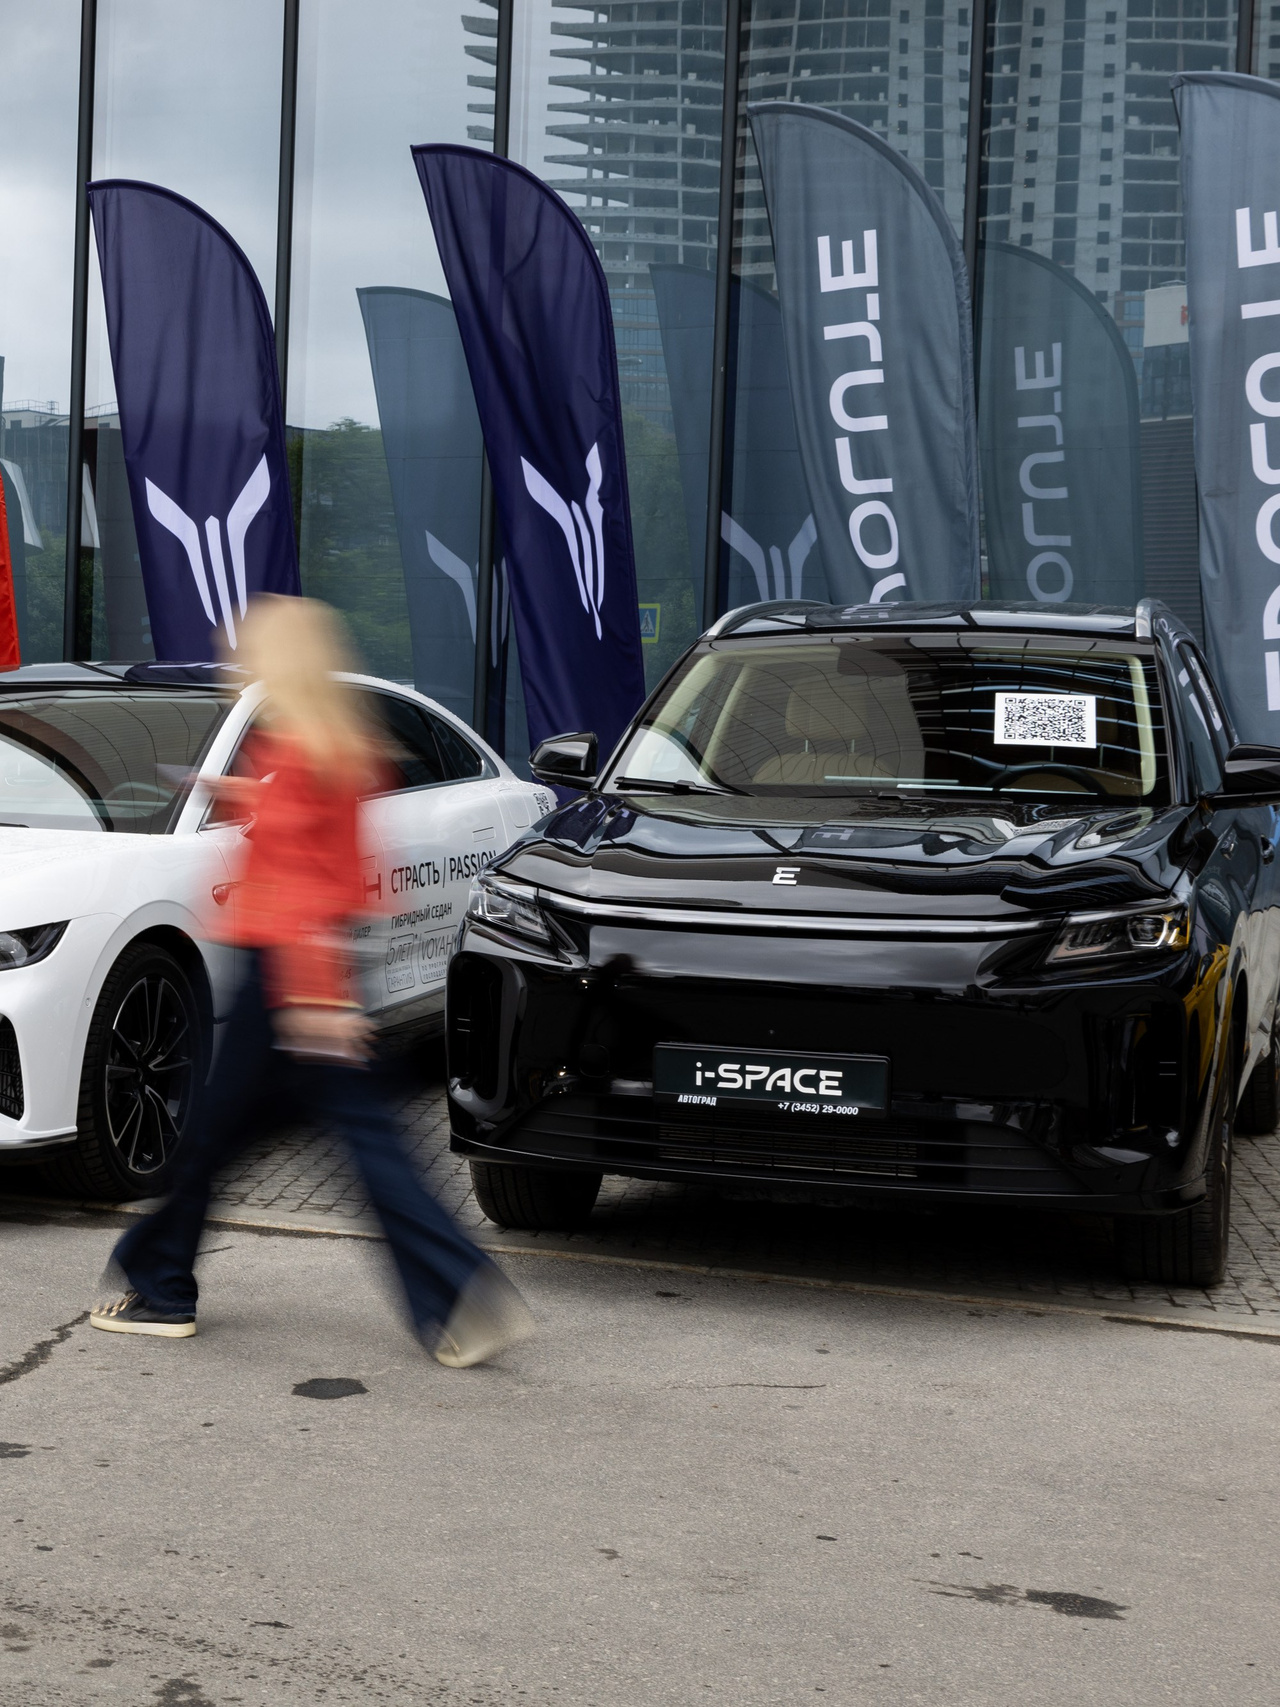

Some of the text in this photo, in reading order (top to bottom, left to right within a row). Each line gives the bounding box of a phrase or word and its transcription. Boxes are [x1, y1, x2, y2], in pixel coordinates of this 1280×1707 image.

[391, 861, 440, 894] СТРАСТЬ
[391, 902, 453, 930] ГИБРИДНЫЙ СЕДАН
[695, 1061, 843, 1097] i-SPACE
[677, 1094, 718, 1106] АВТОГРАД
[777, 1101, 859, 1116] +7 (3452) 29-0000
